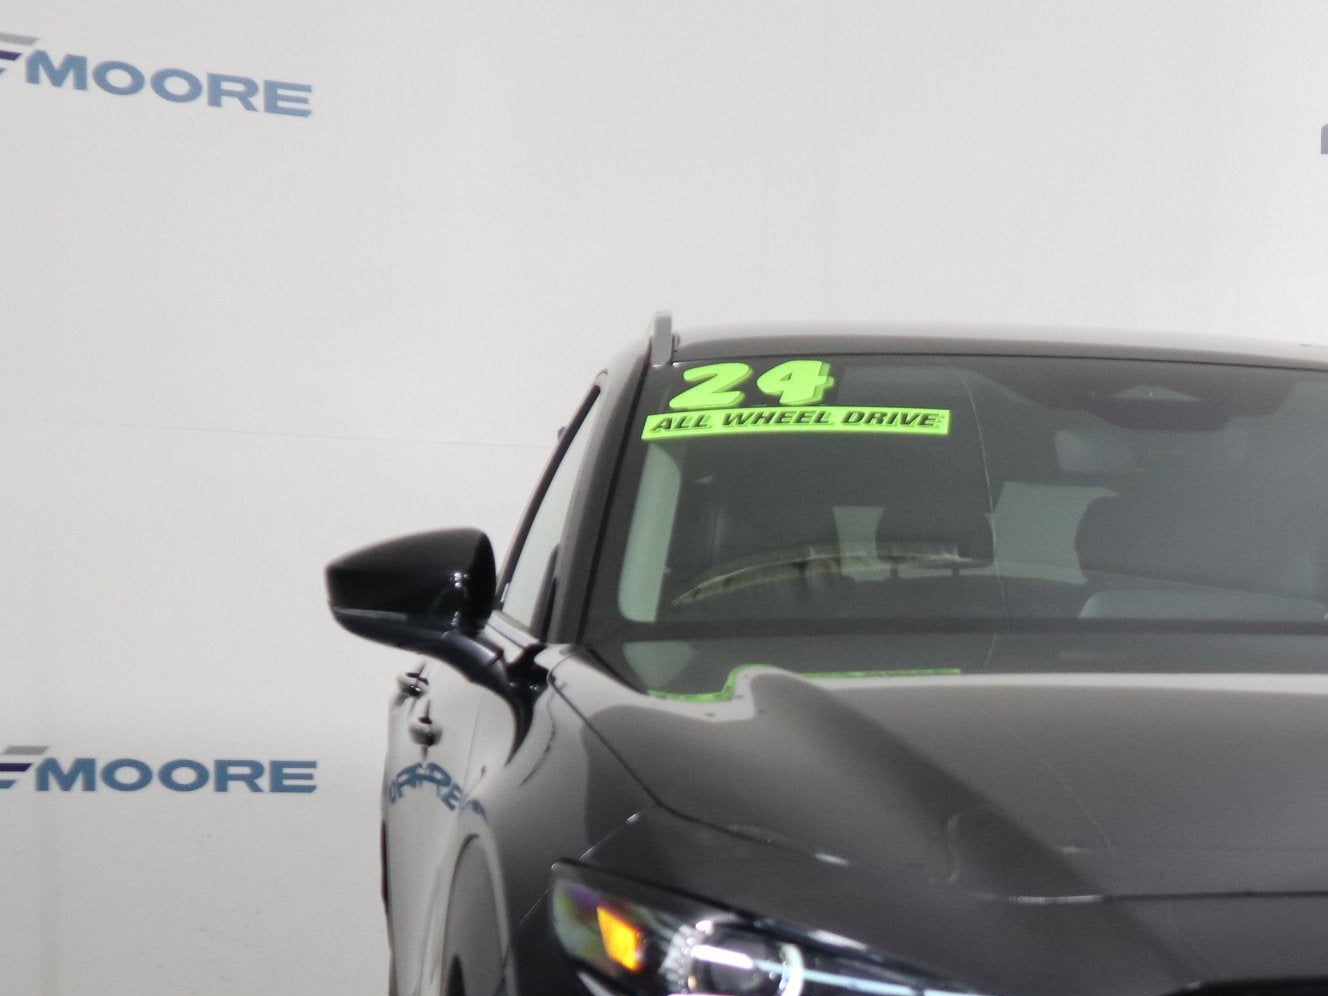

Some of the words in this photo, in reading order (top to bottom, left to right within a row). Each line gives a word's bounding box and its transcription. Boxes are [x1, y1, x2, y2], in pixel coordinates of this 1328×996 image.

[25, 49, 313, 118] MOORE
[668, 359, 834, 410] 24
[651, 415, 712, 432] ALL
[722, 409, 832, 427] WHEEL
[841, 410, 944, 428] DRIVE
[35, 757, 318, 794] MOORE
